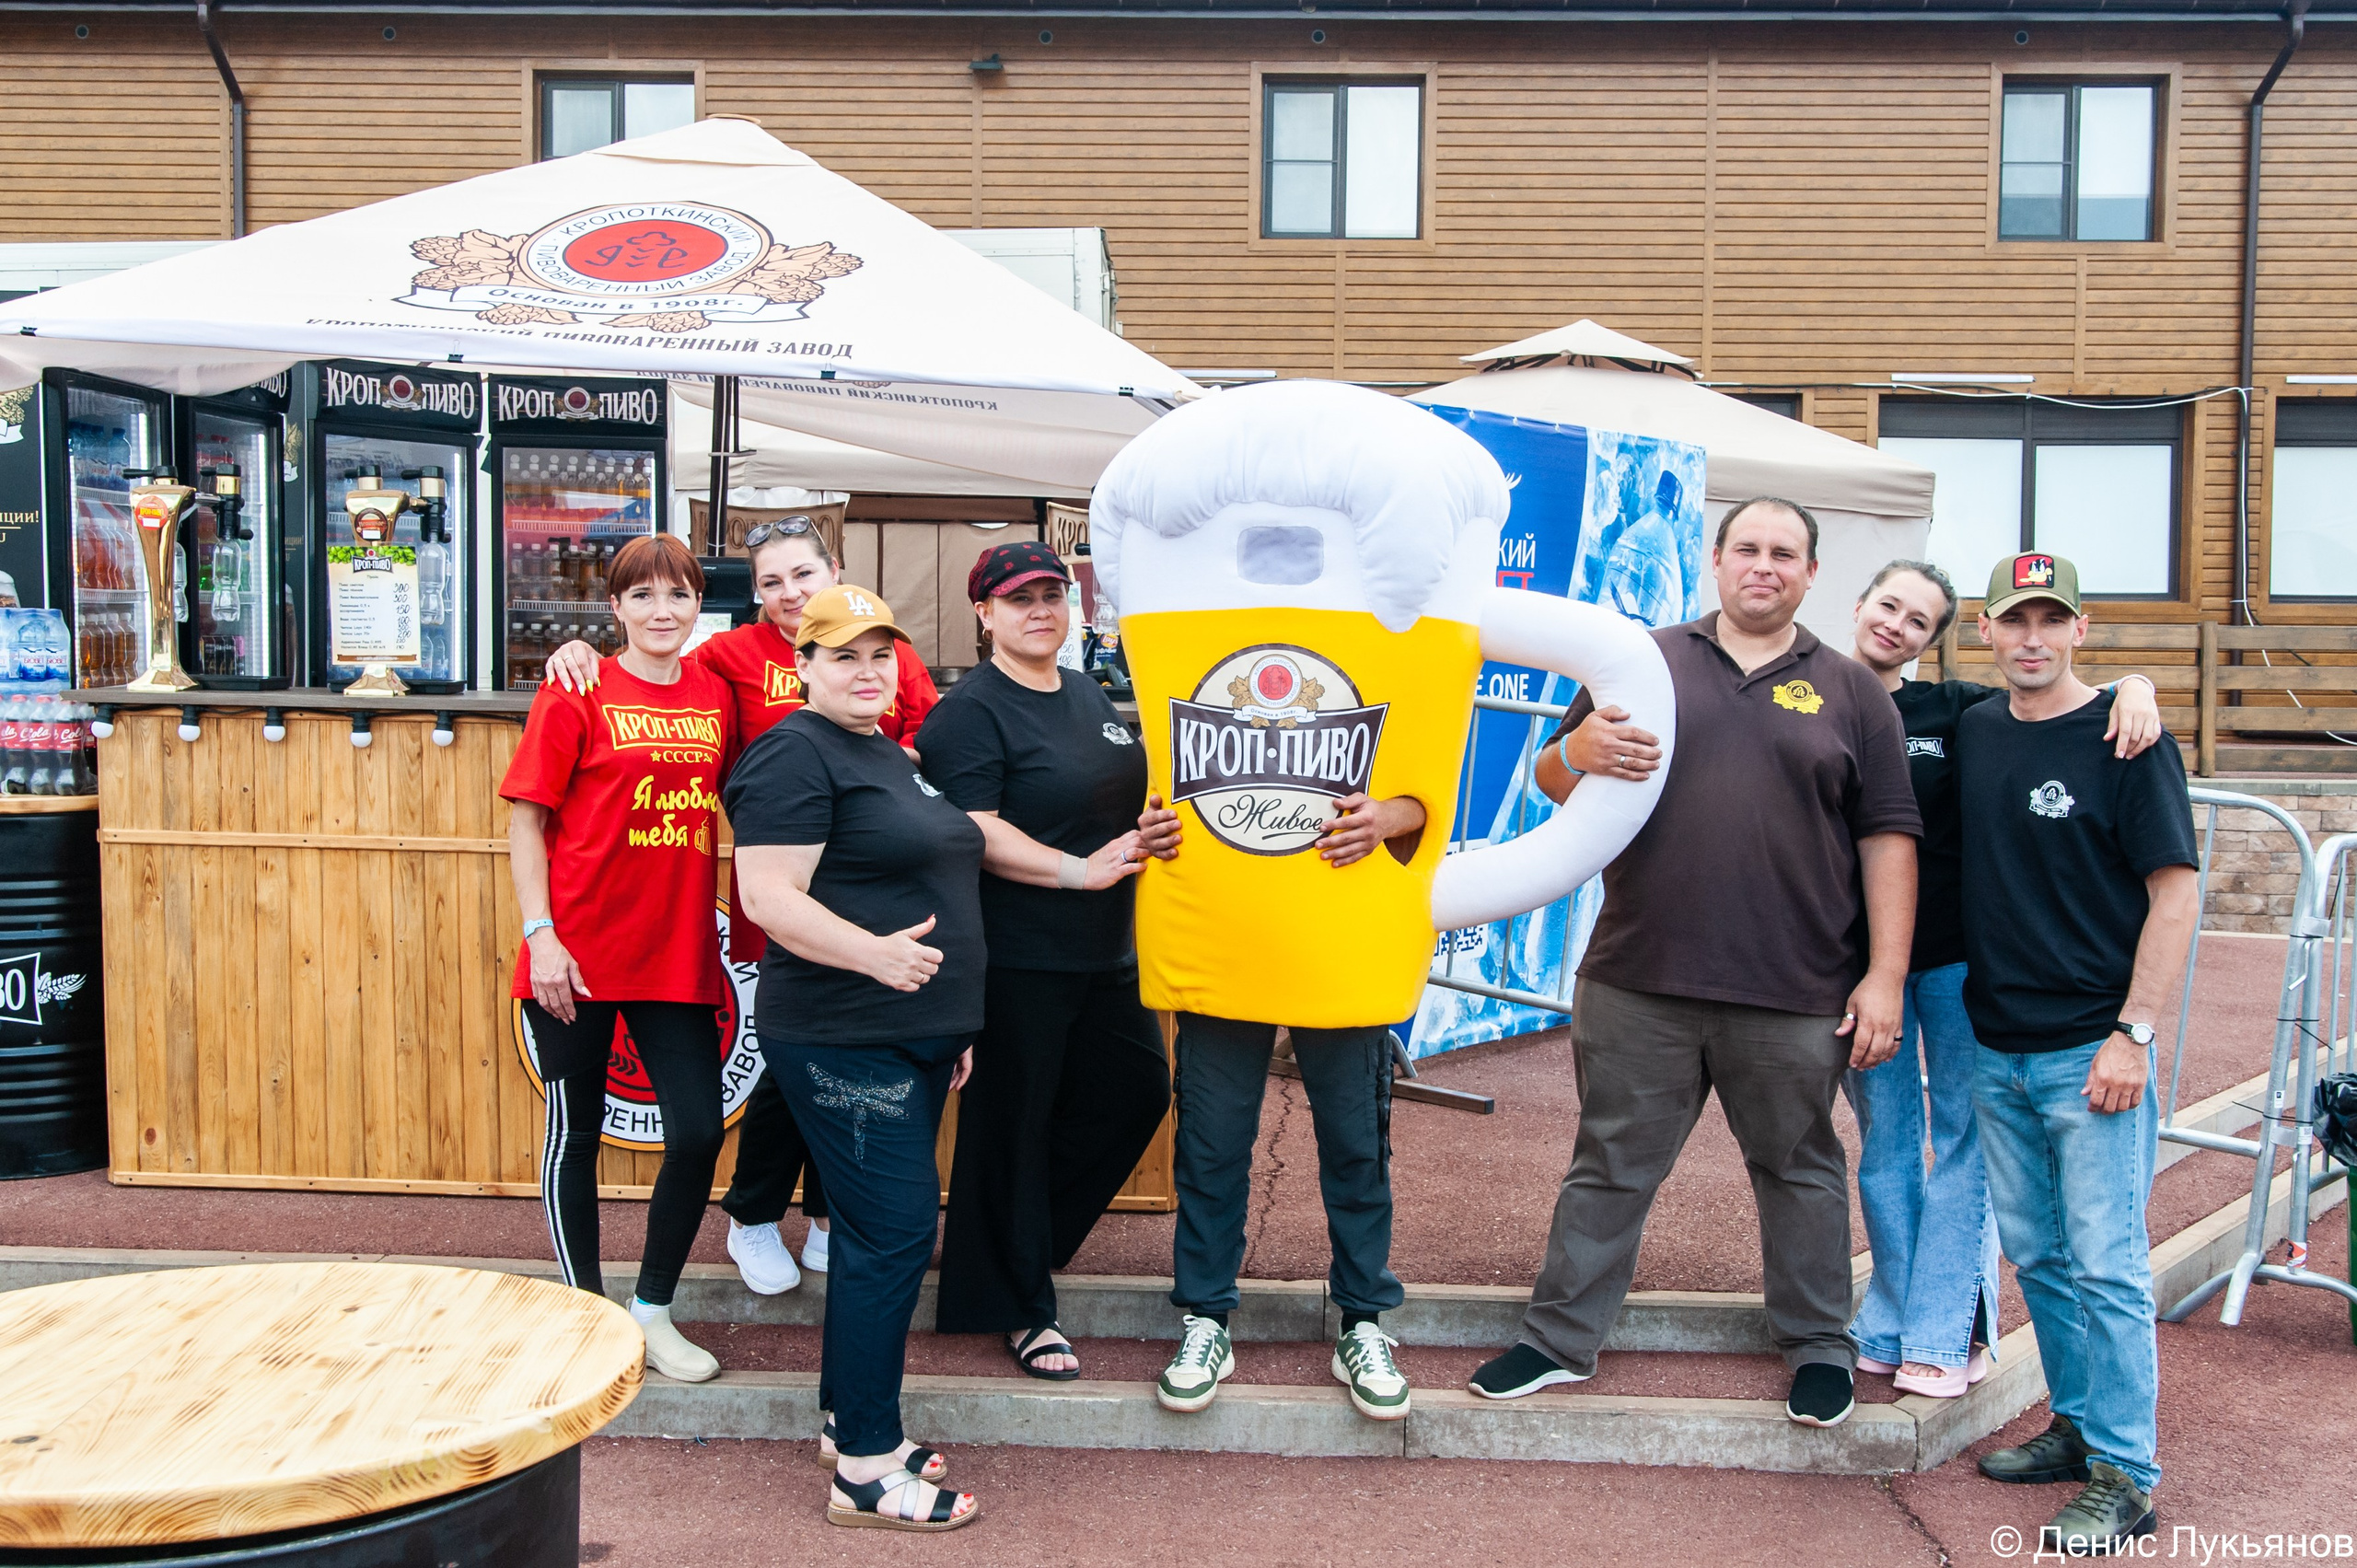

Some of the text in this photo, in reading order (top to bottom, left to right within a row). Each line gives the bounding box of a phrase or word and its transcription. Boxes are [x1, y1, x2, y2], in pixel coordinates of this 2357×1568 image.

[559, 205, 757, 243] КРОПОТКИНСКИЙ
[537, 243, 755, 293] ПИВОВАРЕННЫЙ ЗАВОД
[488, 288, 607, 309] Основан
[649, 297, 744, 308] 1908г.
[766, 341, 854, 360] ЗАВОД
[326, 366, 476, 420] КРОП ПИВО
[498, 384, 658, 425] КРОП ПИВО
[0, 510, 40, 525] ции!
[843, 590, 876, 617] LA
[662, 750, 703, 763] СССР
[631, 775, 655, 810] Я
[628, 813, 689, 847] тебя
[1217, 794, 1324, 834] Живое
